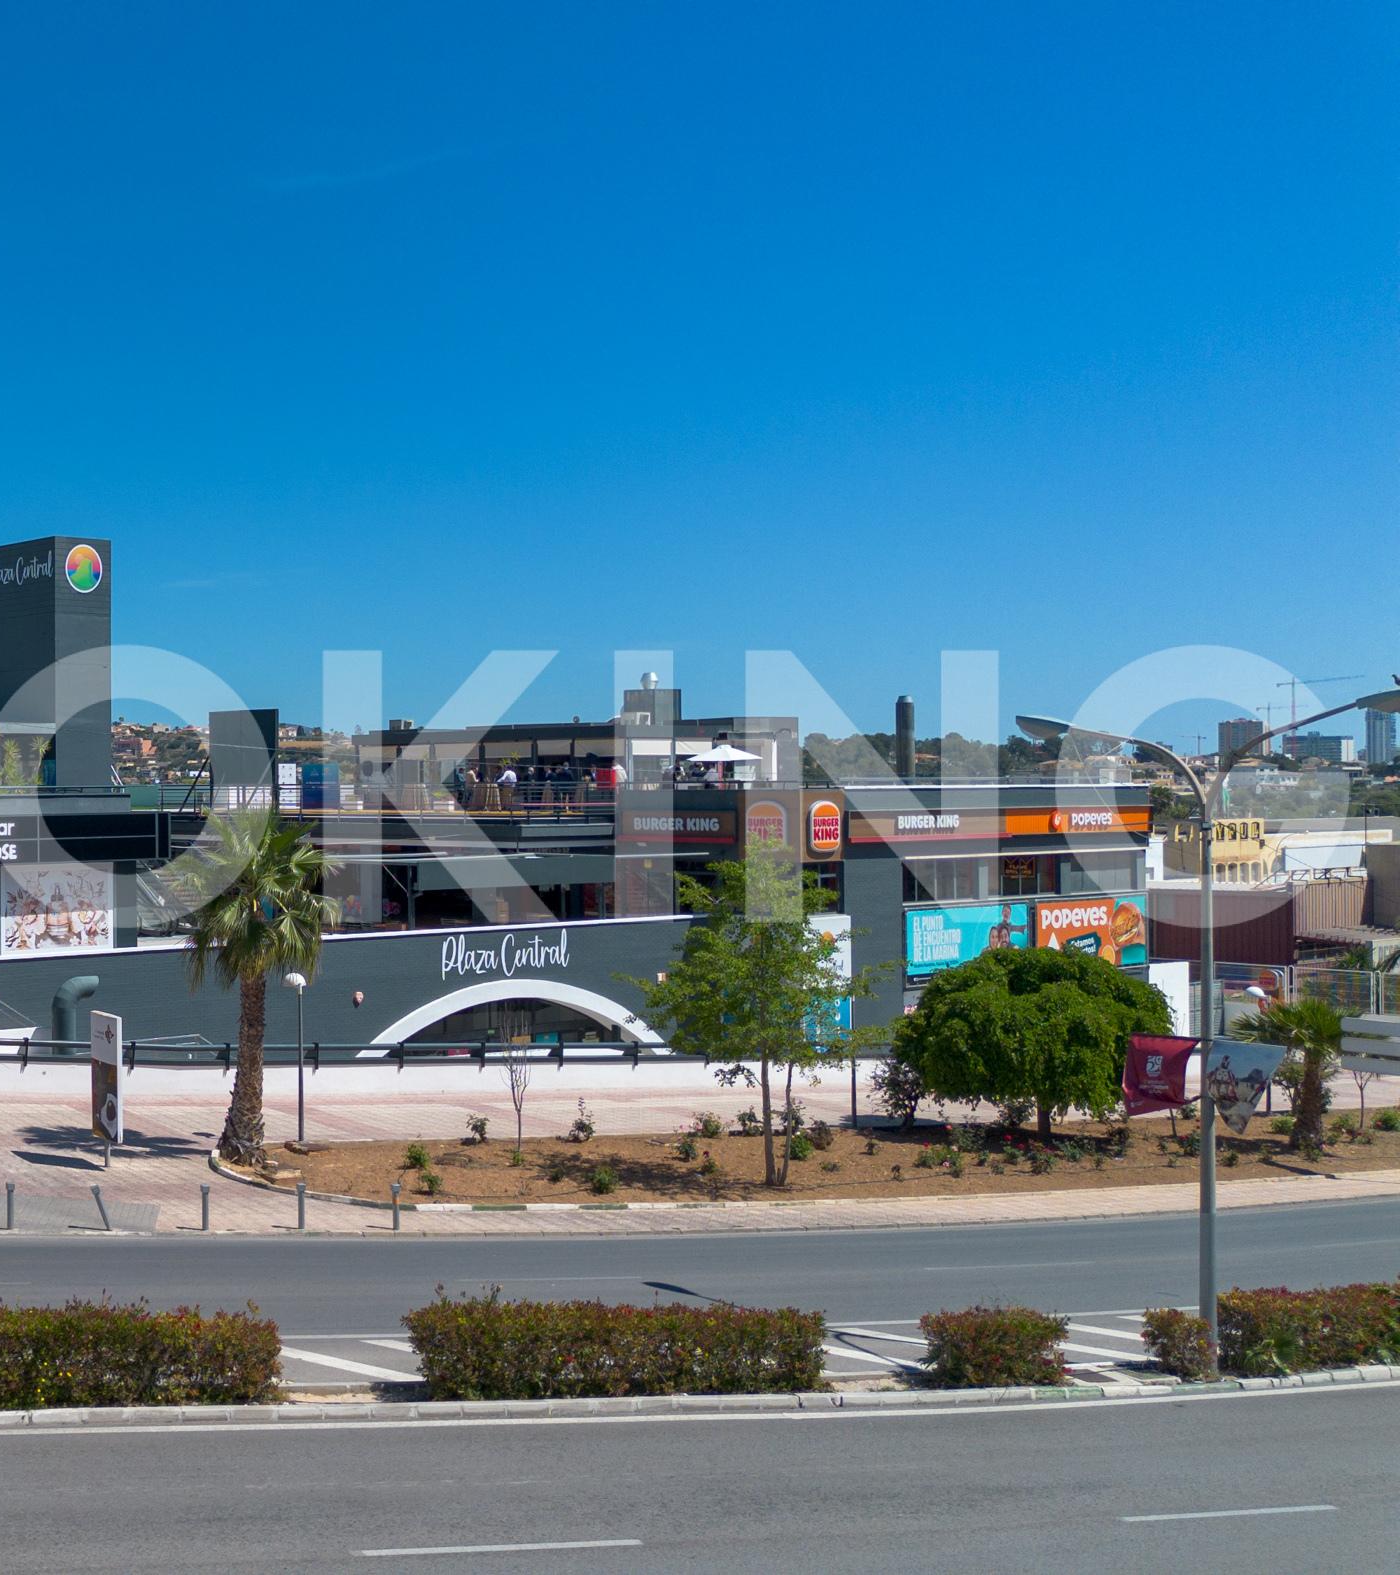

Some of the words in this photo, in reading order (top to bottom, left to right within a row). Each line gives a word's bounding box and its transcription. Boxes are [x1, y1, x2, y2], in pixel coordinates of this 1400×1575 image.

[16, 550, 53, 585] Central
[634, 817, 683, 831] BURGER
[686, 817, 720, 831] KING
[813, 818, 839, 827] BURGER
[898, 815, 935, 829] BURGER
[936, 814, 960, 829] KING
[813, 827, 839, 841] KING
[913, 916, 920, 931] EL
[921, 915, 944, 930] PUNTO
[913, 931, 922, 946] DE
[923, 929, 961, 946] ENCUENTRO
[442, 934, 499, 981] Plaza
[501, 928, 570, 976] Central
[913, 946, 922, 962] DE
[923, 945, 931, 961] LA
[932, 944, 960, 960] MARINA
